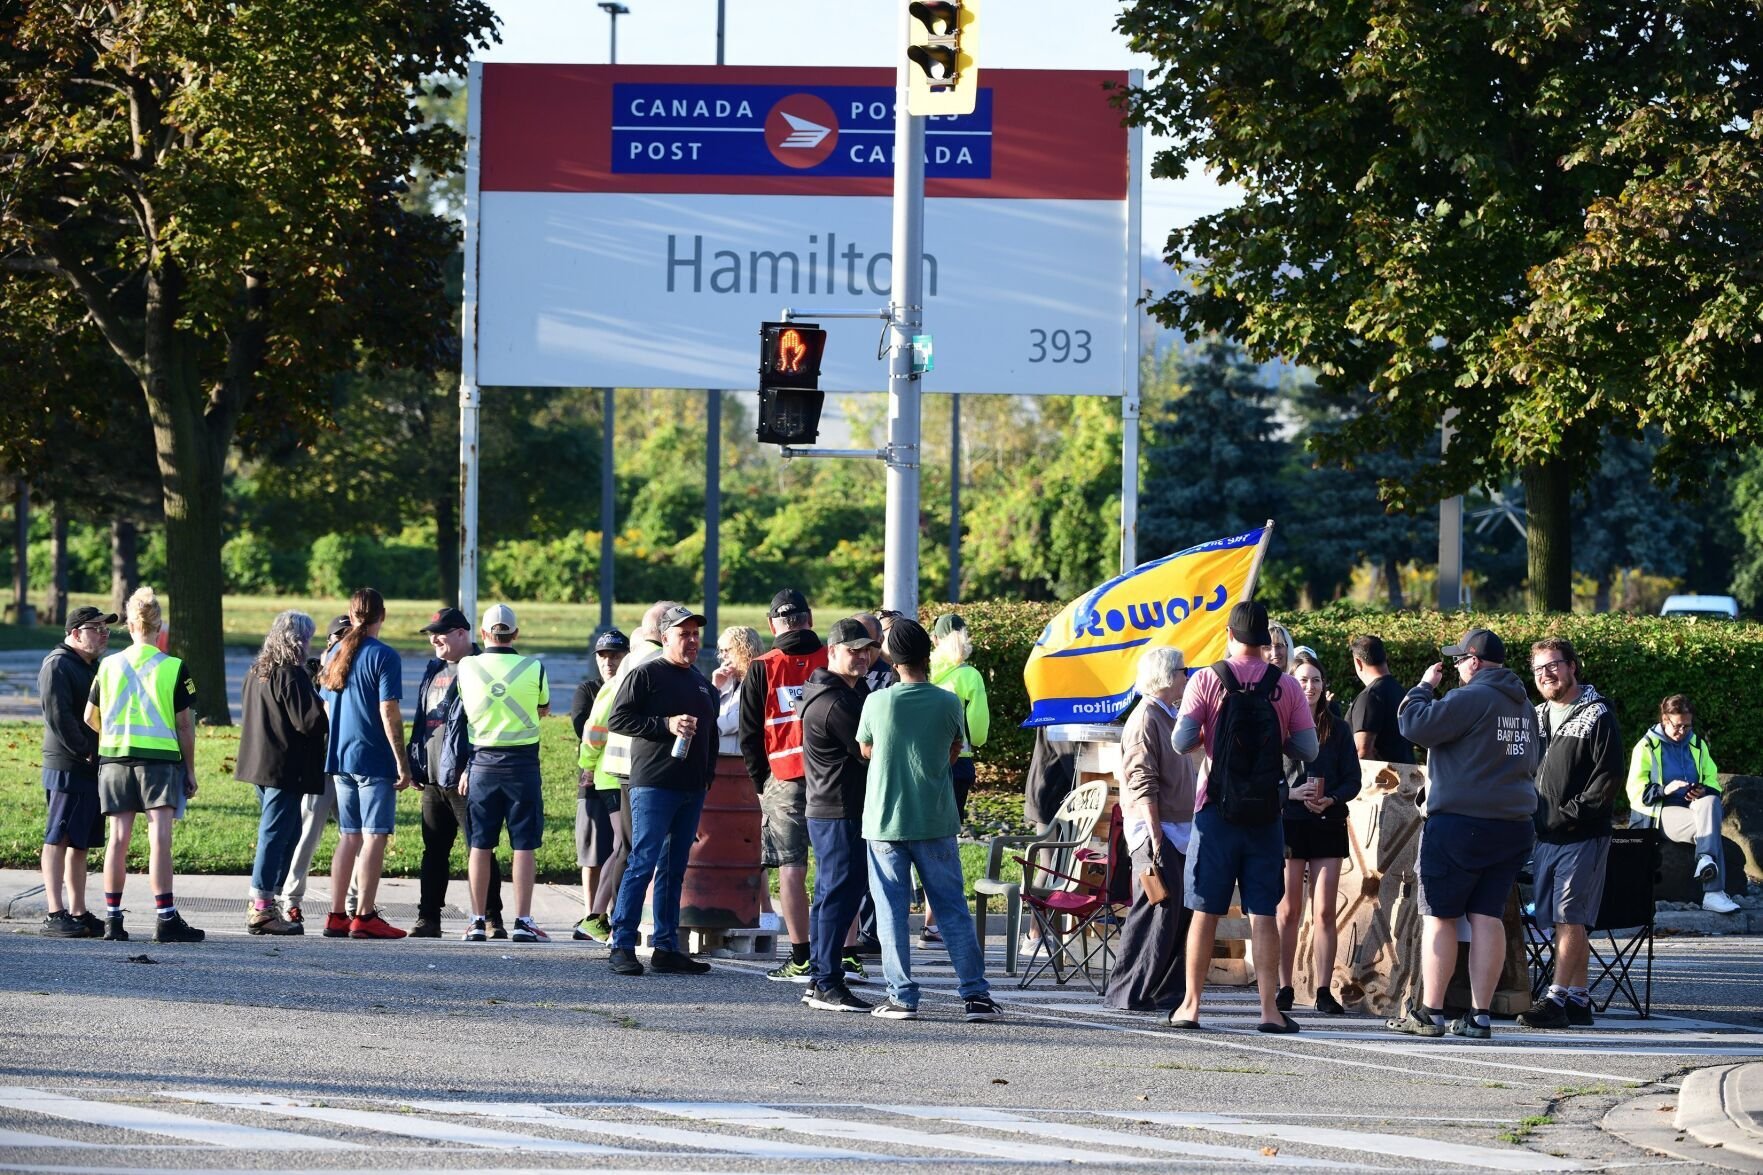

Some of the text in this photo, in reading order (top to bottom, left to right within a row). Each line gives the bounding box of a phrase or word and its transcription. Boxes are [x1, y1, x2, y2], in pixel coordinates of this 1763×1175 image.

[631, 99, 753, 117] CANADA
[630, 142, 702, 160] POST
[849, 145, 973, 164] CADA
[1028, 329, 1092, 363] 393
[1497, 716, 1501, 728] I
[1502, 716, 1520, 729] WANT
